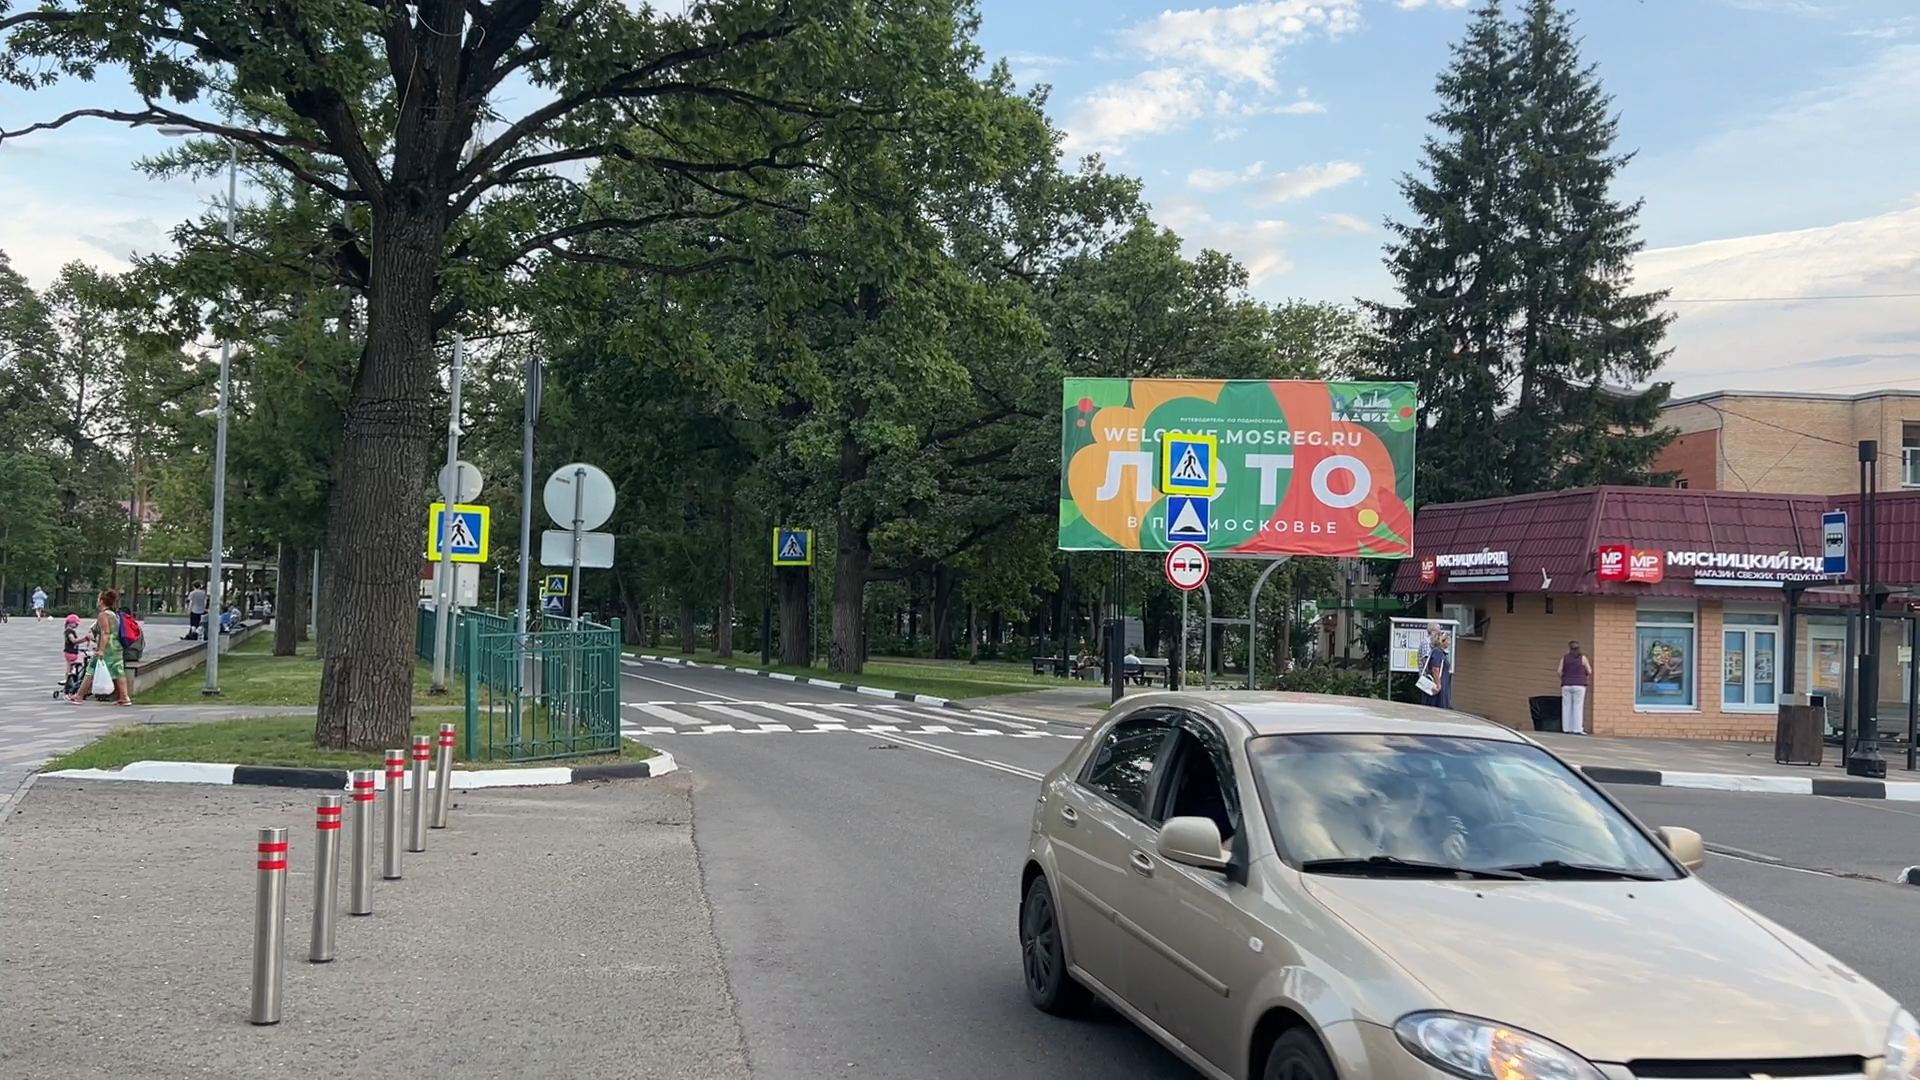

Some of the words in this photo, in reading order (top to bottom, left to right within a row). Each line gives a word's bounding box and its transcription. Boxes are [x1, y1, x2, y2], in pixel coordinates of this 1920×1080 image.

[1127, 516, 1138, 528] В
[1152, 516, 1337, 534] ПМОСКОВЬЕ
[1436, 551, 1487, 568] МЯСНИЦКИЙ
[1488, 551, 1508, 566] РЯД
[1667, 551, 1789, 570] МЯСНИЦКИЙ
[1694, 569, 1735, 579] МАГАЗИН
[1737, 570, 1773, 580] СВЕЖИХ
